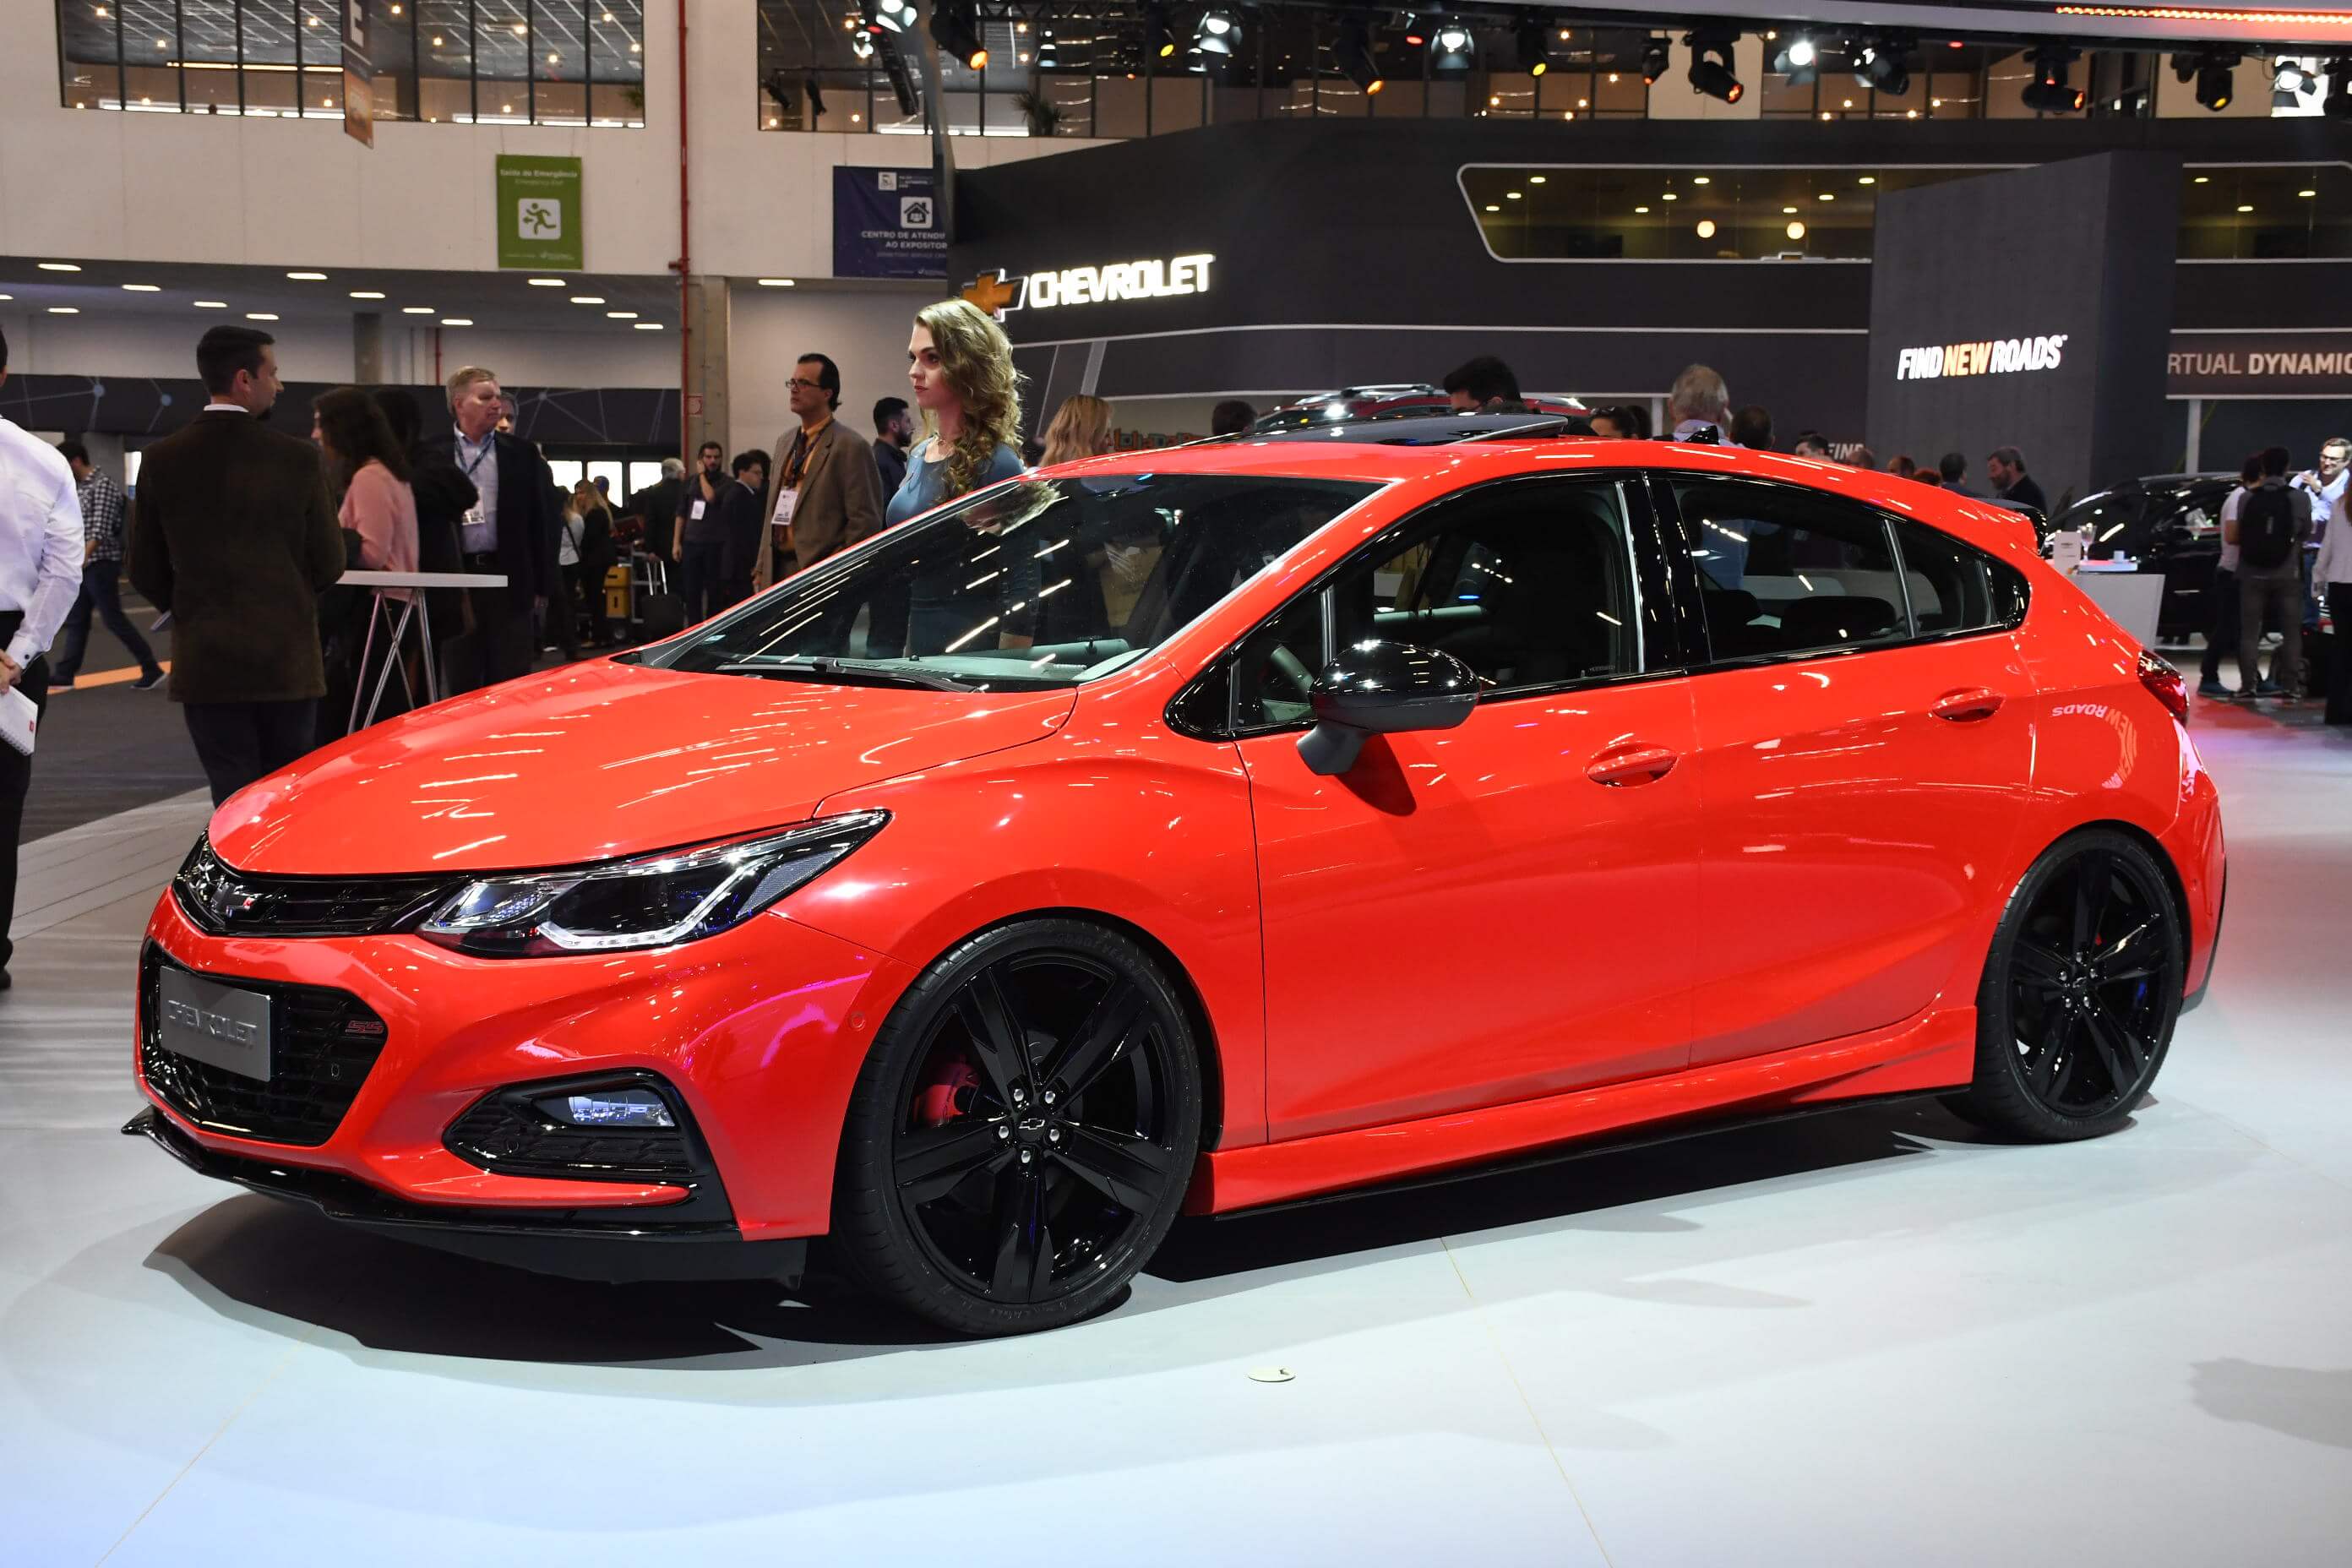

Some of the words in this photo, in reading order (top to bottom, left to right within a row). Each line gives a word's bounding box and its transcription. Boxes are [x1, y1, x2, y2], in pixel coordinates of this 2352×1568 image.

[1029, 254, 1216, 308] CHEVROLET
[1897, 346, 1944, 380] FIND
[1942, 341, 1993, 376] NEW
